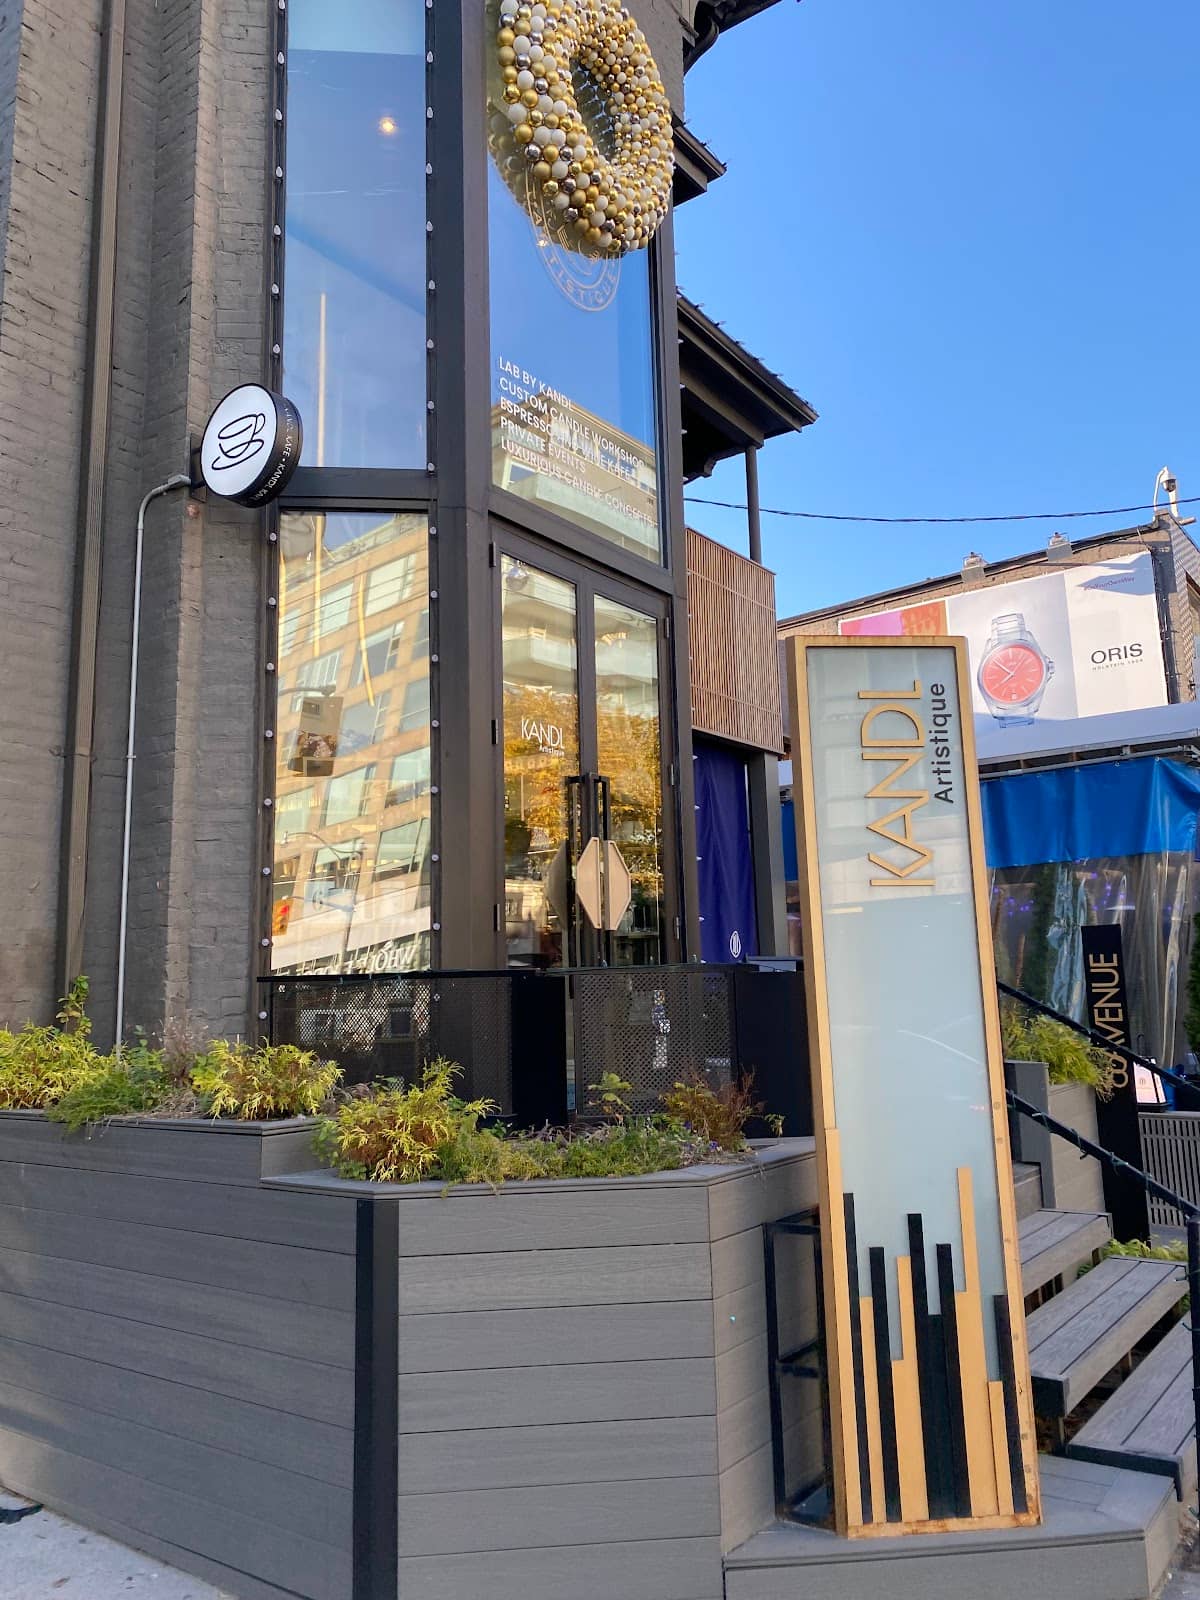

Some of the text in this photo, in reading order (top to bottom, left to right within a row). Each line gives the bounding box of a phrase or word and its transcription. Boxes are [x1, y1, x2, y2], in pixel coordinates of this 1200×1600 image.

[499, 356, 574, 411] LAB BY KANDL
[500, 396, 553, 437] ESPRESSO
[500, 376, 645, 468] CUSTOM CANDLE WORKSHOP
[500, 415, 586, 473] PRIVATE EVENTS
[501, 437, 562, 480] LUXURIOUS
[564, 470, 602, 500] CANDLE
[1091, 643, 1143, 664] ORIS
[520, 717, 565, 749] KANDL
[929, 683, 954, 804] Artistique
[858, 679, 936, 886] KANDL
